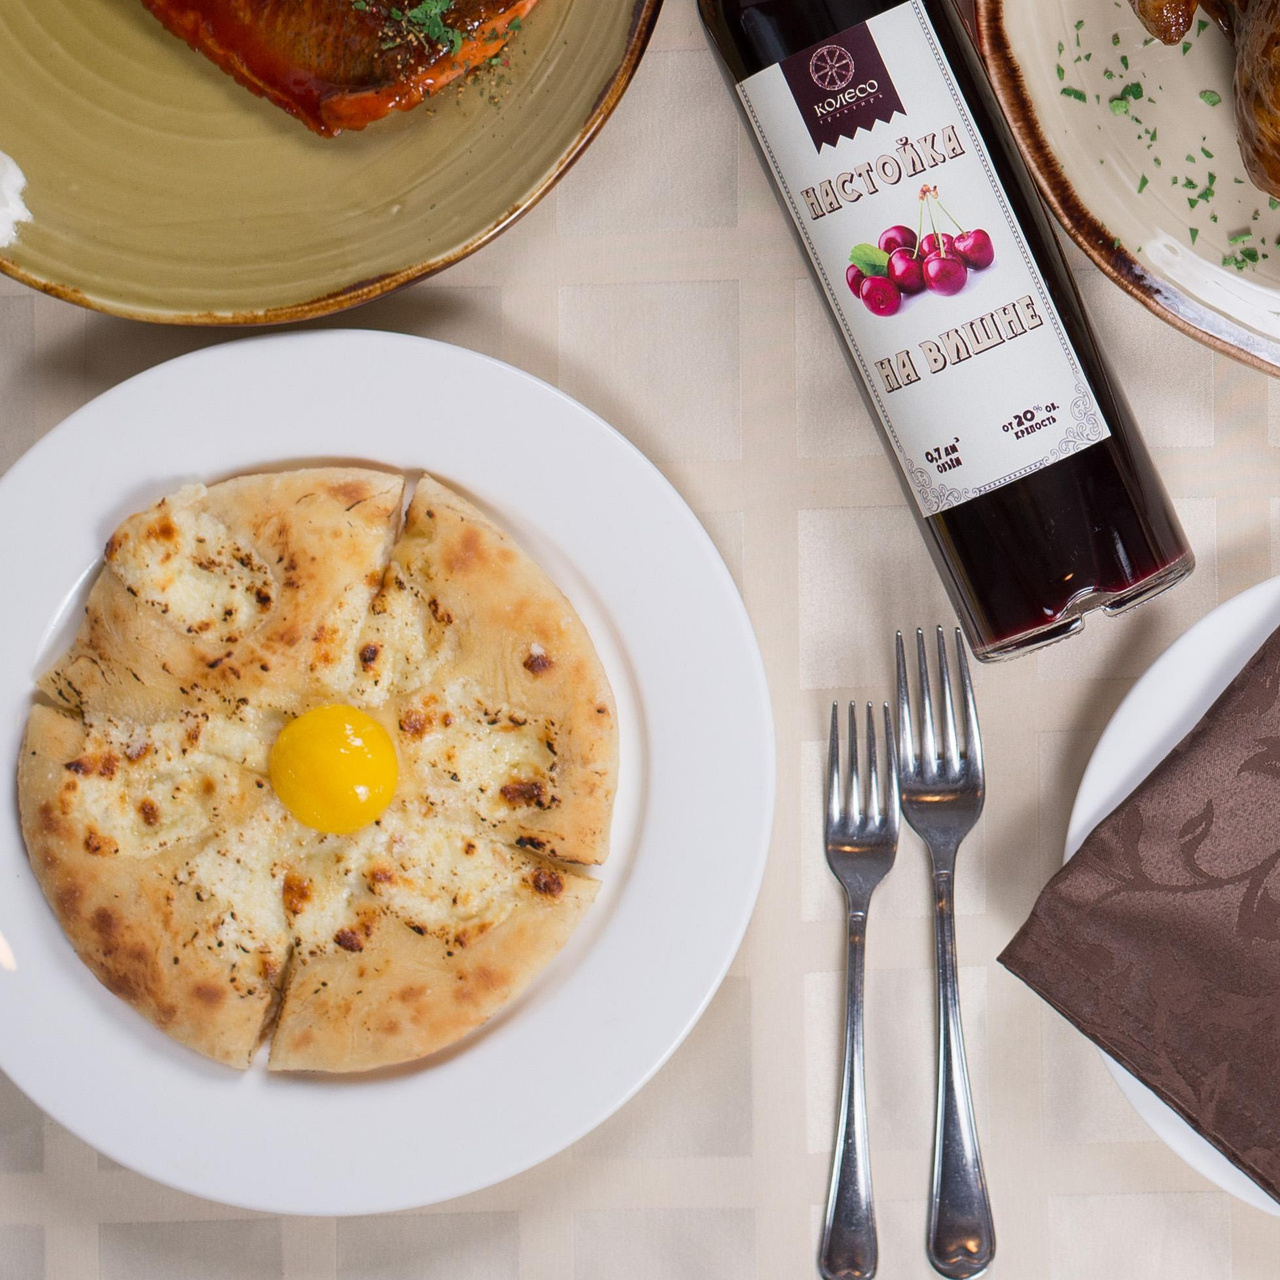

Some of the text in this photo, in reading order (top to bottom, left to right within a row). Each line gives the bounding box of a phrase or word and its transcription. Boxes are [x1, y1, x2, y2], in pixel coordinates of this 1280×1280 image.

[813, 80, 878, 117] КОЛЕСО
[800, 125, 966, 220] НАСТОЙКА
[874, 295, 1044, 393] НА ВИШНЕ
[1014, 415, 1057, 440] КРЕПОСТЬ
[925, 446, 942, 464] 0,7
